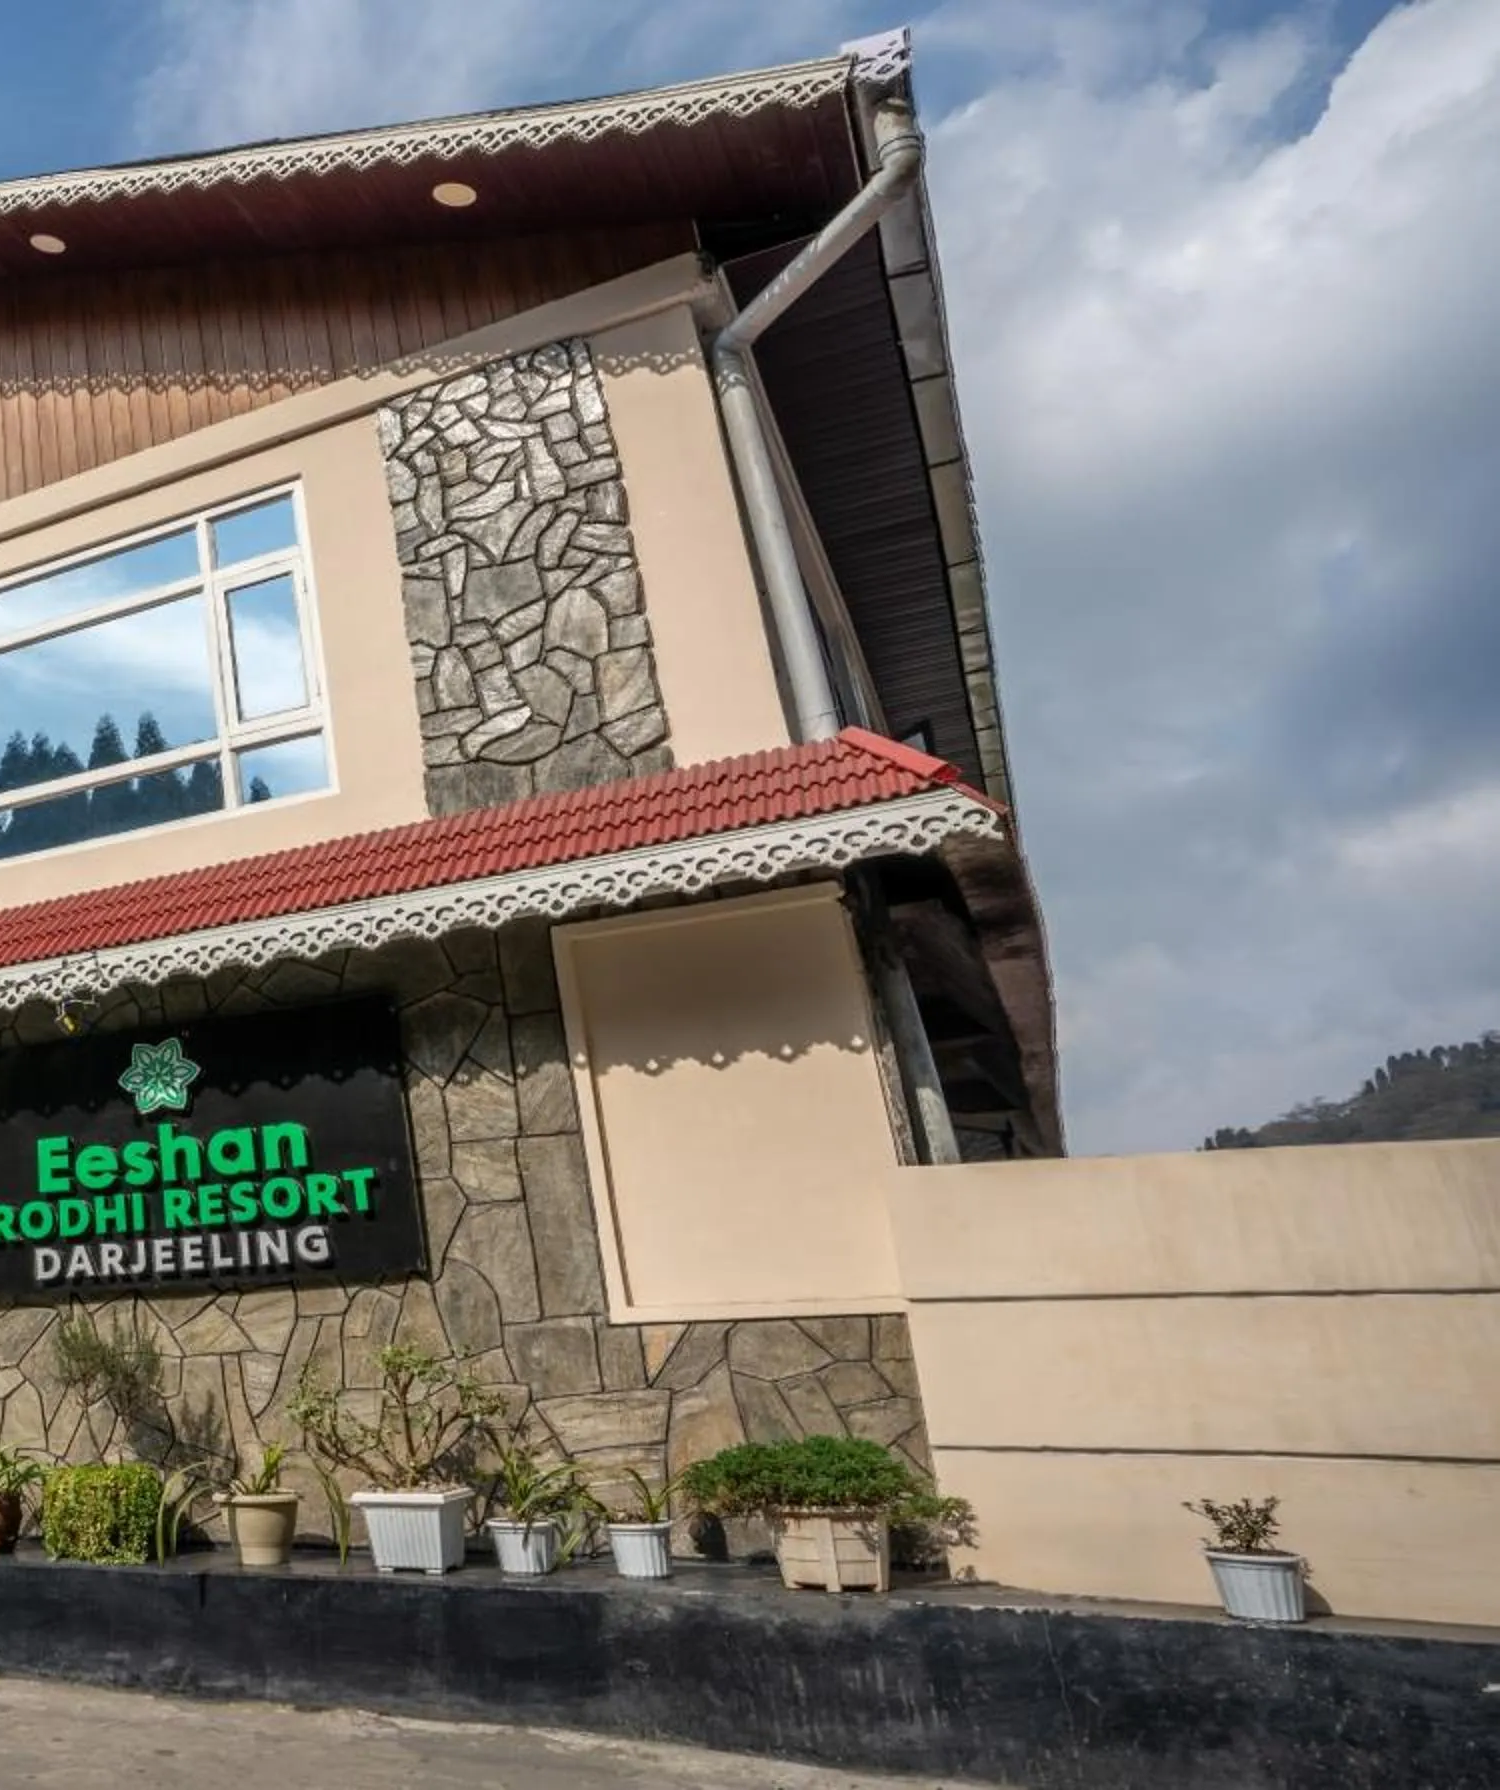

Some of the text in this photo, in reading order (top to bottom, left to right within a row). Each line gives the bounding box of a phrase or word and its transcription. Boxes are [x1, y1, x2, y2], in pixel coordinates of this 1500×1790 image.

[37, 1121, 309, 1193] Eeshan
[164, 1168, 376, 1229] RESORT
[34, 1226, 330, 1281] DARJEELING
